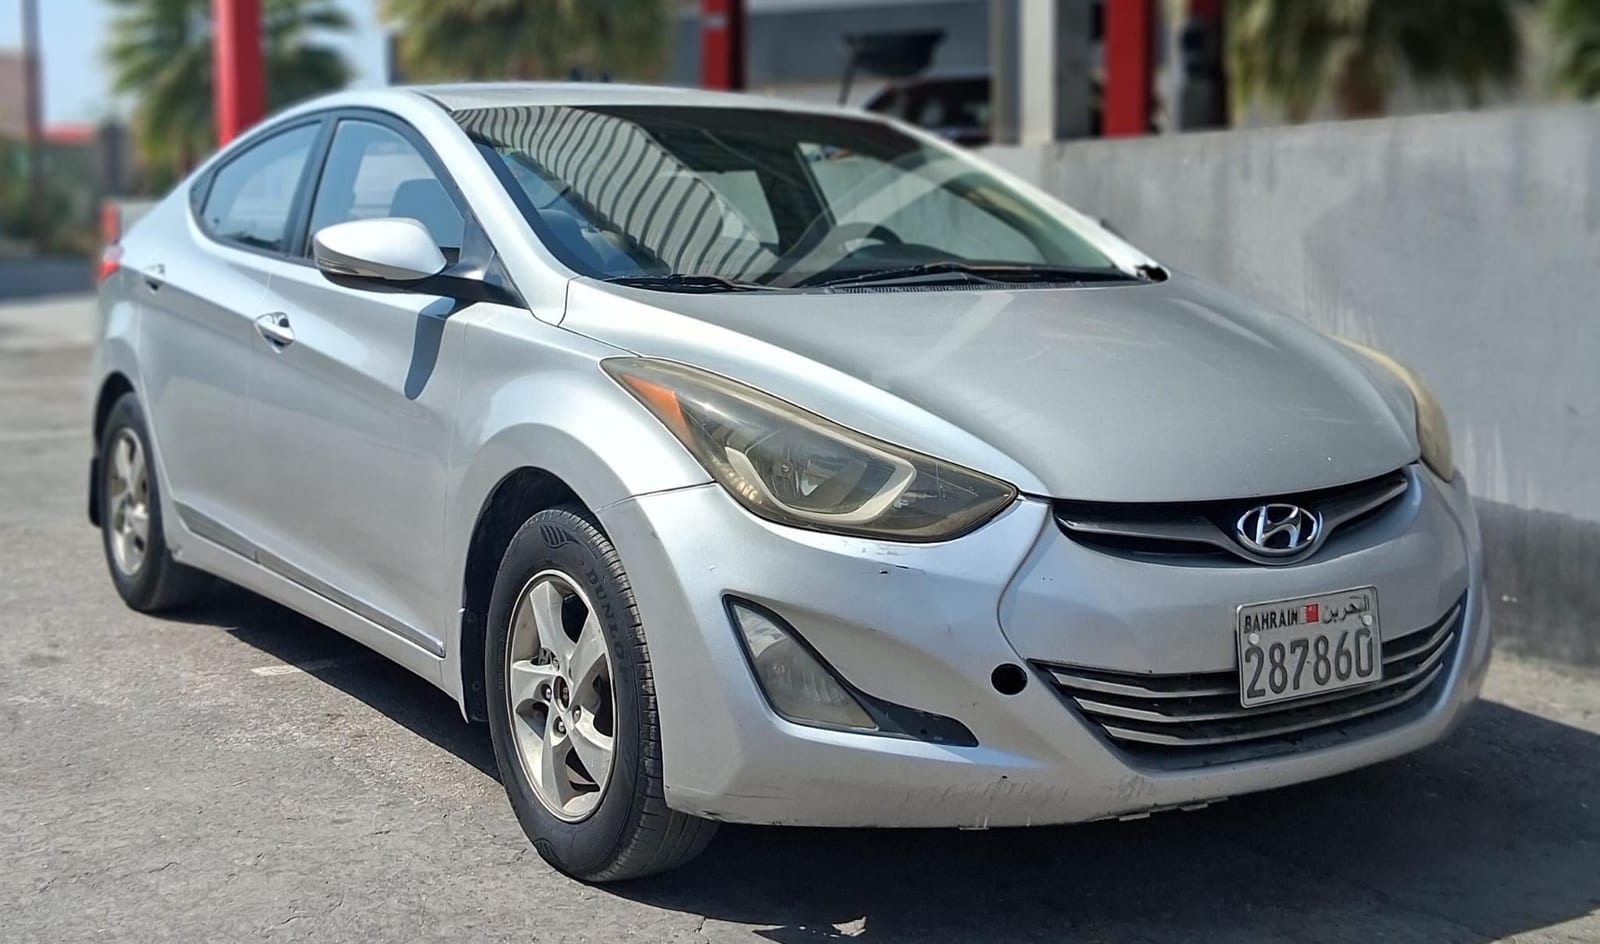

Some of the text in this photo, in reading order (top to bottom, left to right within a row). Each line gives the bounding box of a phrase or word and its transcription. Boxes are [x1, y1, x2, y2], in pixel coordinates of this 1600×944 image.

[587, 568, 628, 672] DUNLO
[1244, 609, 1298, 634] BAHRAIN
[1245, 627, 1374, 699] 287860
